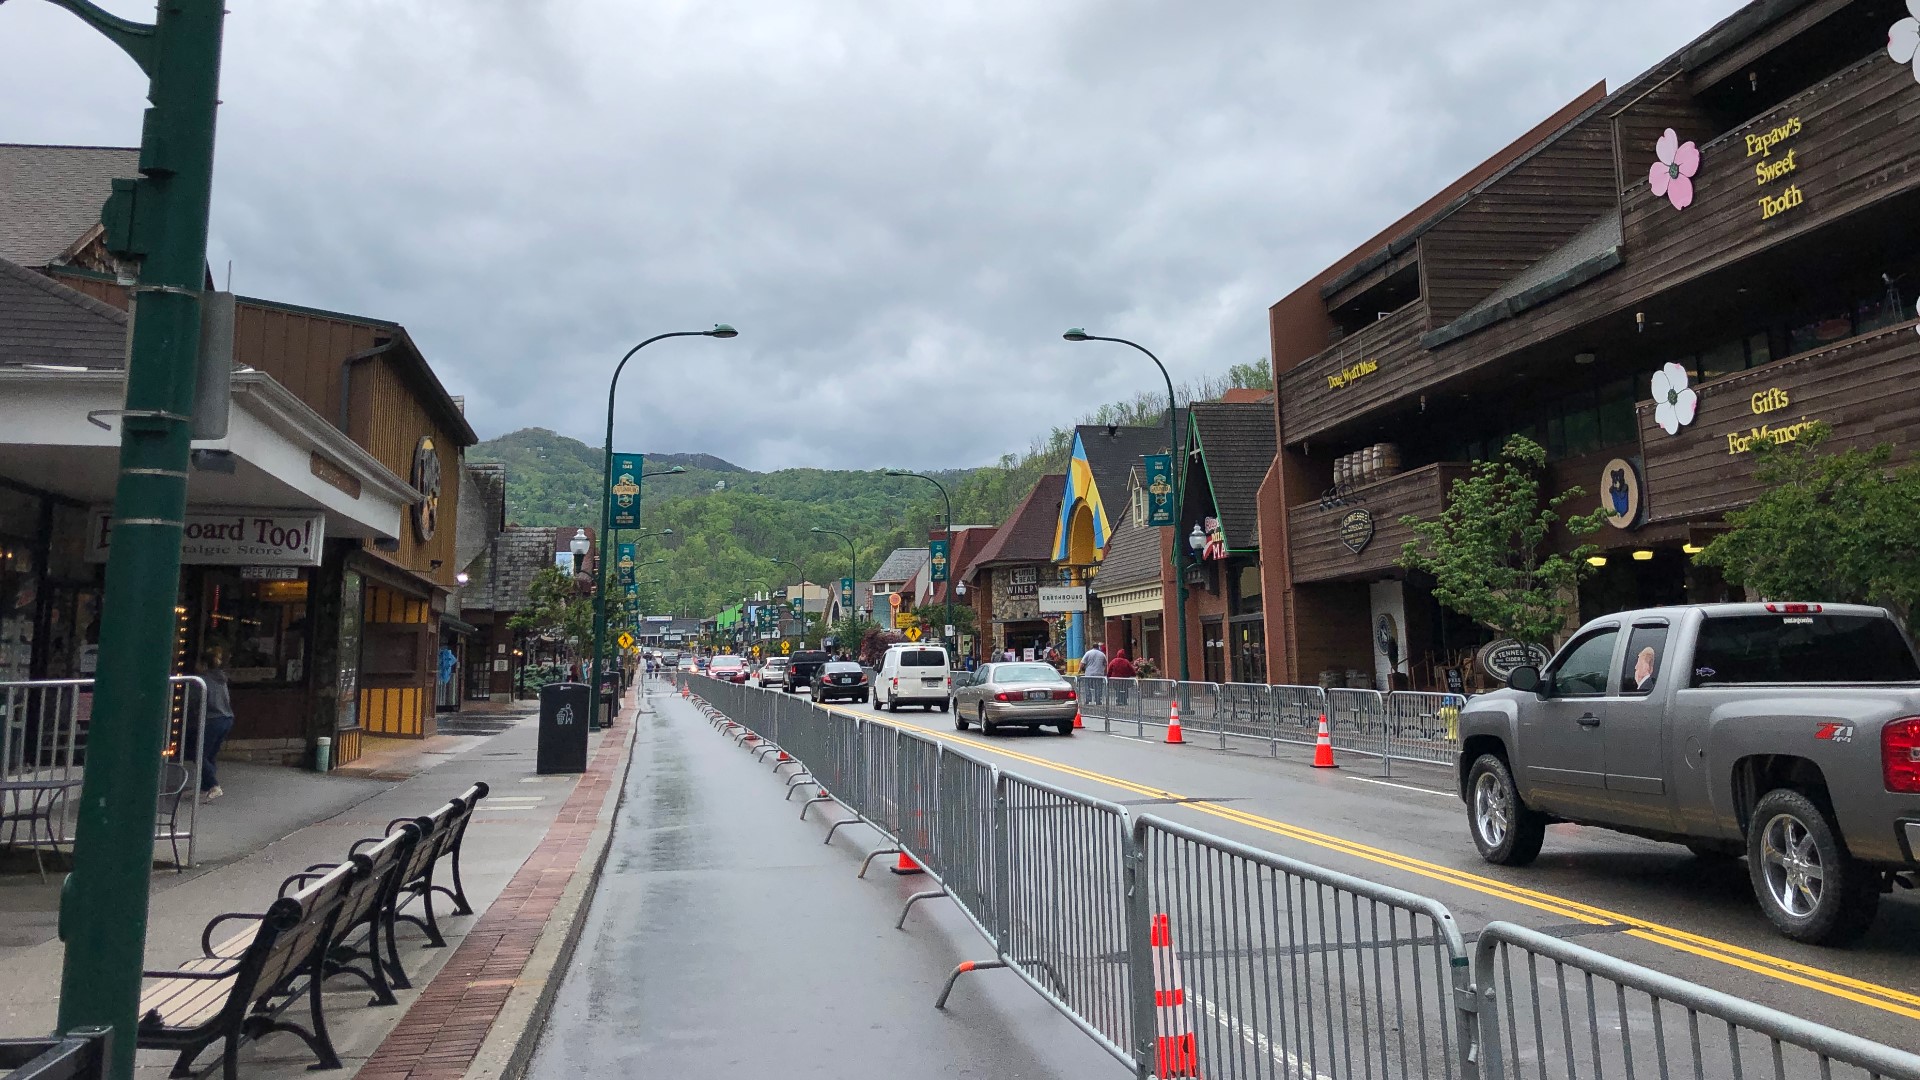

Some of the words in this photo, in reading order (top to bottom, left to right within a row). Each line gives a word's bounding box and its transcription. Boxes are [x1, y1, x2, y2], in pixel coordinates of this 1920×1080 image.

[1744, 117, 1802, 157] Papaw's
[1756, 149, 1797, 186] Sweet
[1759, 183, 1803, 220] Tooth
[1328, 376, 1346, 389] Doug
[1342, 364, 1361, 386] Wyatt
[1359, 358, 1378, 377] Music
[1751, 388, 1790, 415] Gifts
[1727, 432, 1752, 455] For
[254, 518, 311, 554] Too!
[238, 545, 283, 556] Store
[241, 567, 263, 577] FREE
[1498, 649, 1537, 658] TENNESEE
[1814, 722, 1854, 740] Z71
